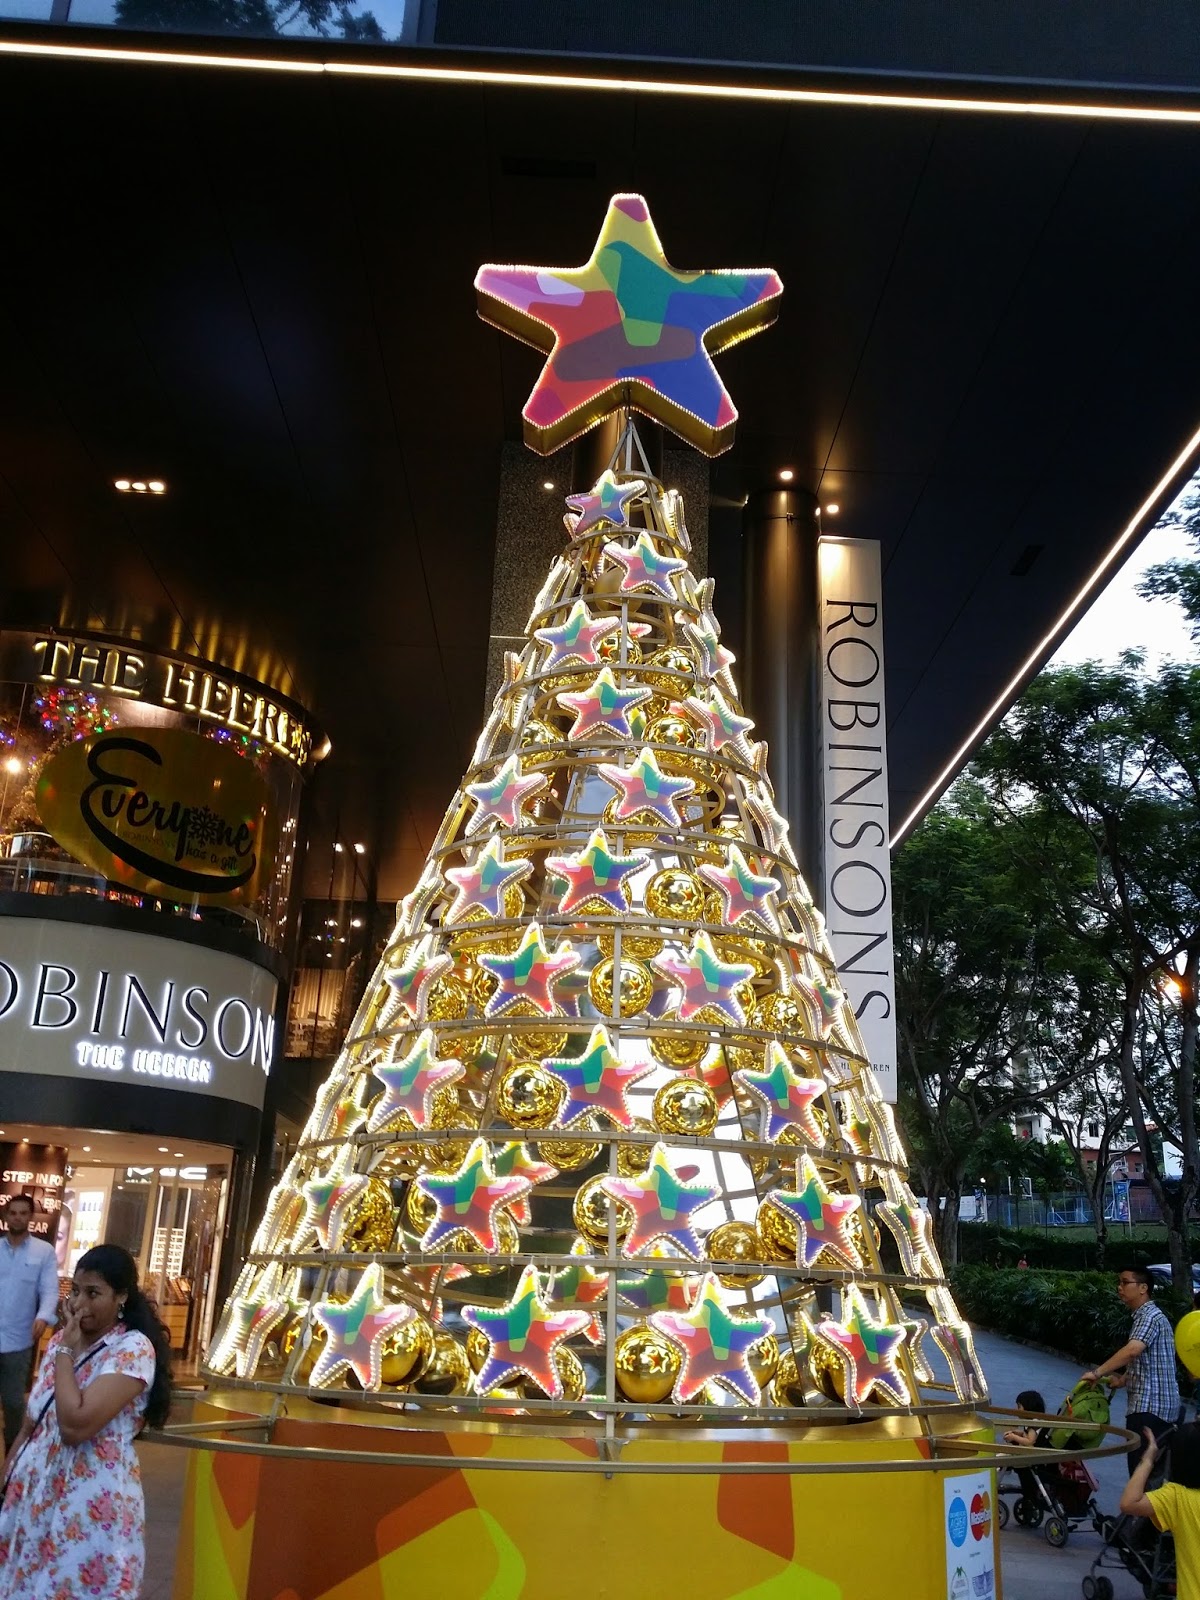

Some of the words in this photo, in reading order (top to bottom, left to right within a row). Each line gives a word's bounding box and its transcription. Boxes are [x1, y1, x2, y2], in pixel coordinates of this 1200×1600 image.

[33, 640, 149, 696] THE
[825, 597, 891, 1021] ROBINSONS
[185, 840, 208, 860] has
[209, 854, 219, 864] a
[219, 855, 239, 872] gift
[76, 1041, 126, 1071] THE
[132, 1049, 212, 1085] HEEREN
[2, 1170, 34, 1184] STEP
[36, 1173, 48, 1185] IN
